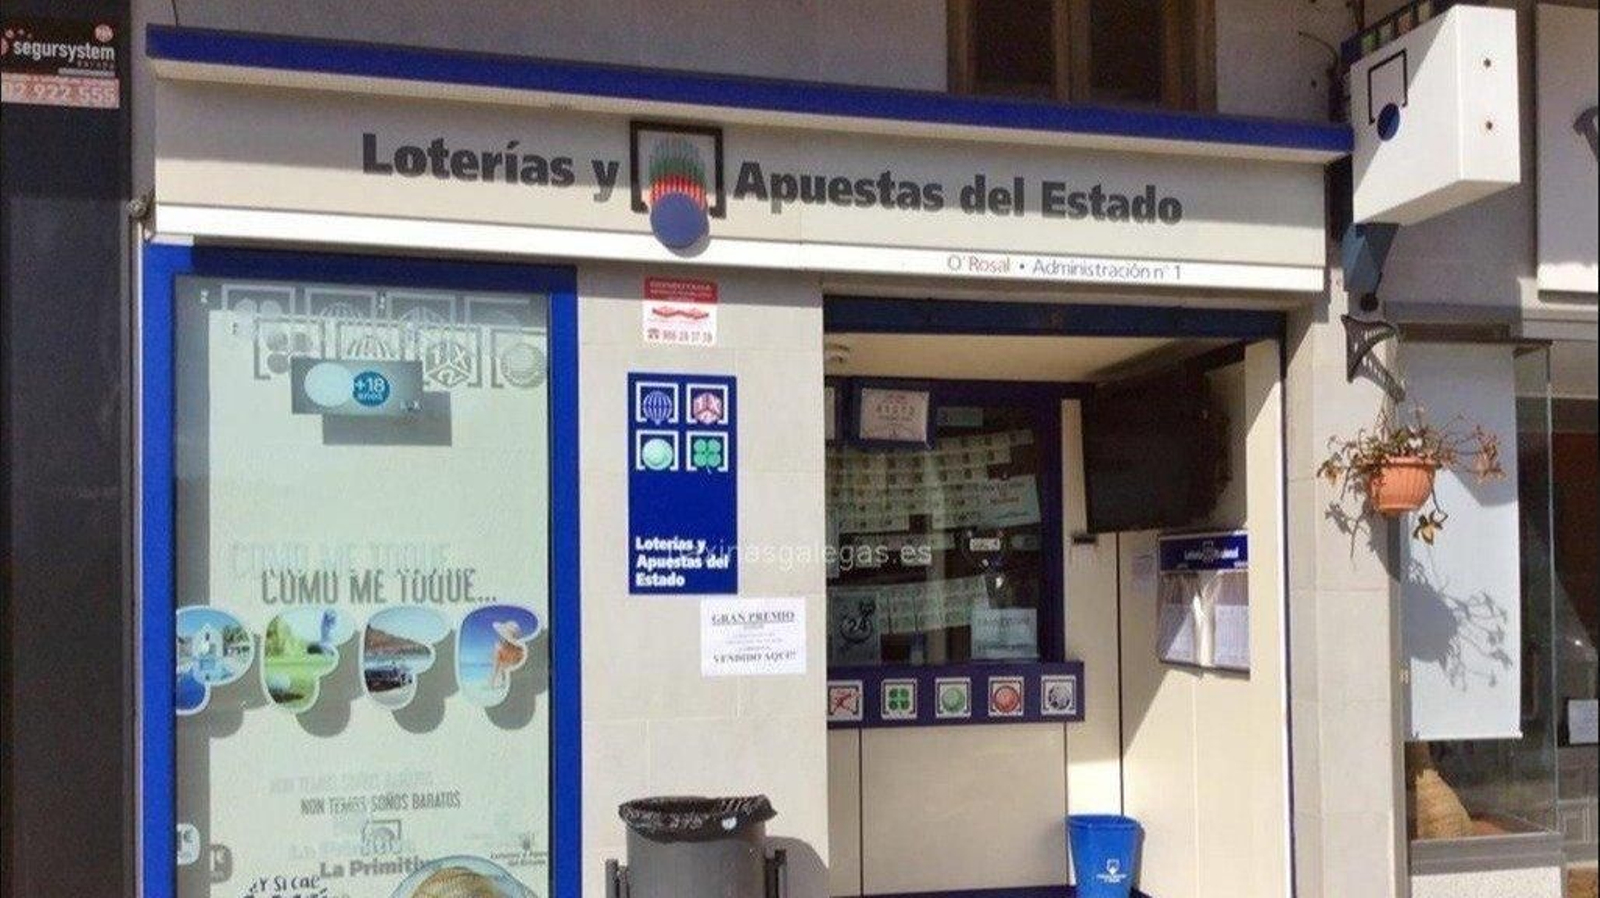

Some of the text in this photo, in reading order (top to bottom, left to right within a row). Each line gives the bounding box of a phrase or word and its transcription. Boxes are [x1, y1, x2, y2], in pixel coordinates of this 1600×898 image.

[13, 41, 115, 63] segursystem
[33, 83, 72, 102] 922
[362, 132, 1183, 225] Loterías y Apuestas del Estado
[1033, 258, 1151, 280] Administración
[1174, 265, 1181, 280] 1
[354, 377, 385, 393] +18
[635, 536, 707, 554] Loterías y
[636, 553, 729, 571] Apuestas del
[350, 568, 386, 604] ME
[635, 571, 685, 587] Estado
[711, 610, 795, 624] GRAN PREMIO
[320, 862, 344, 878] La
